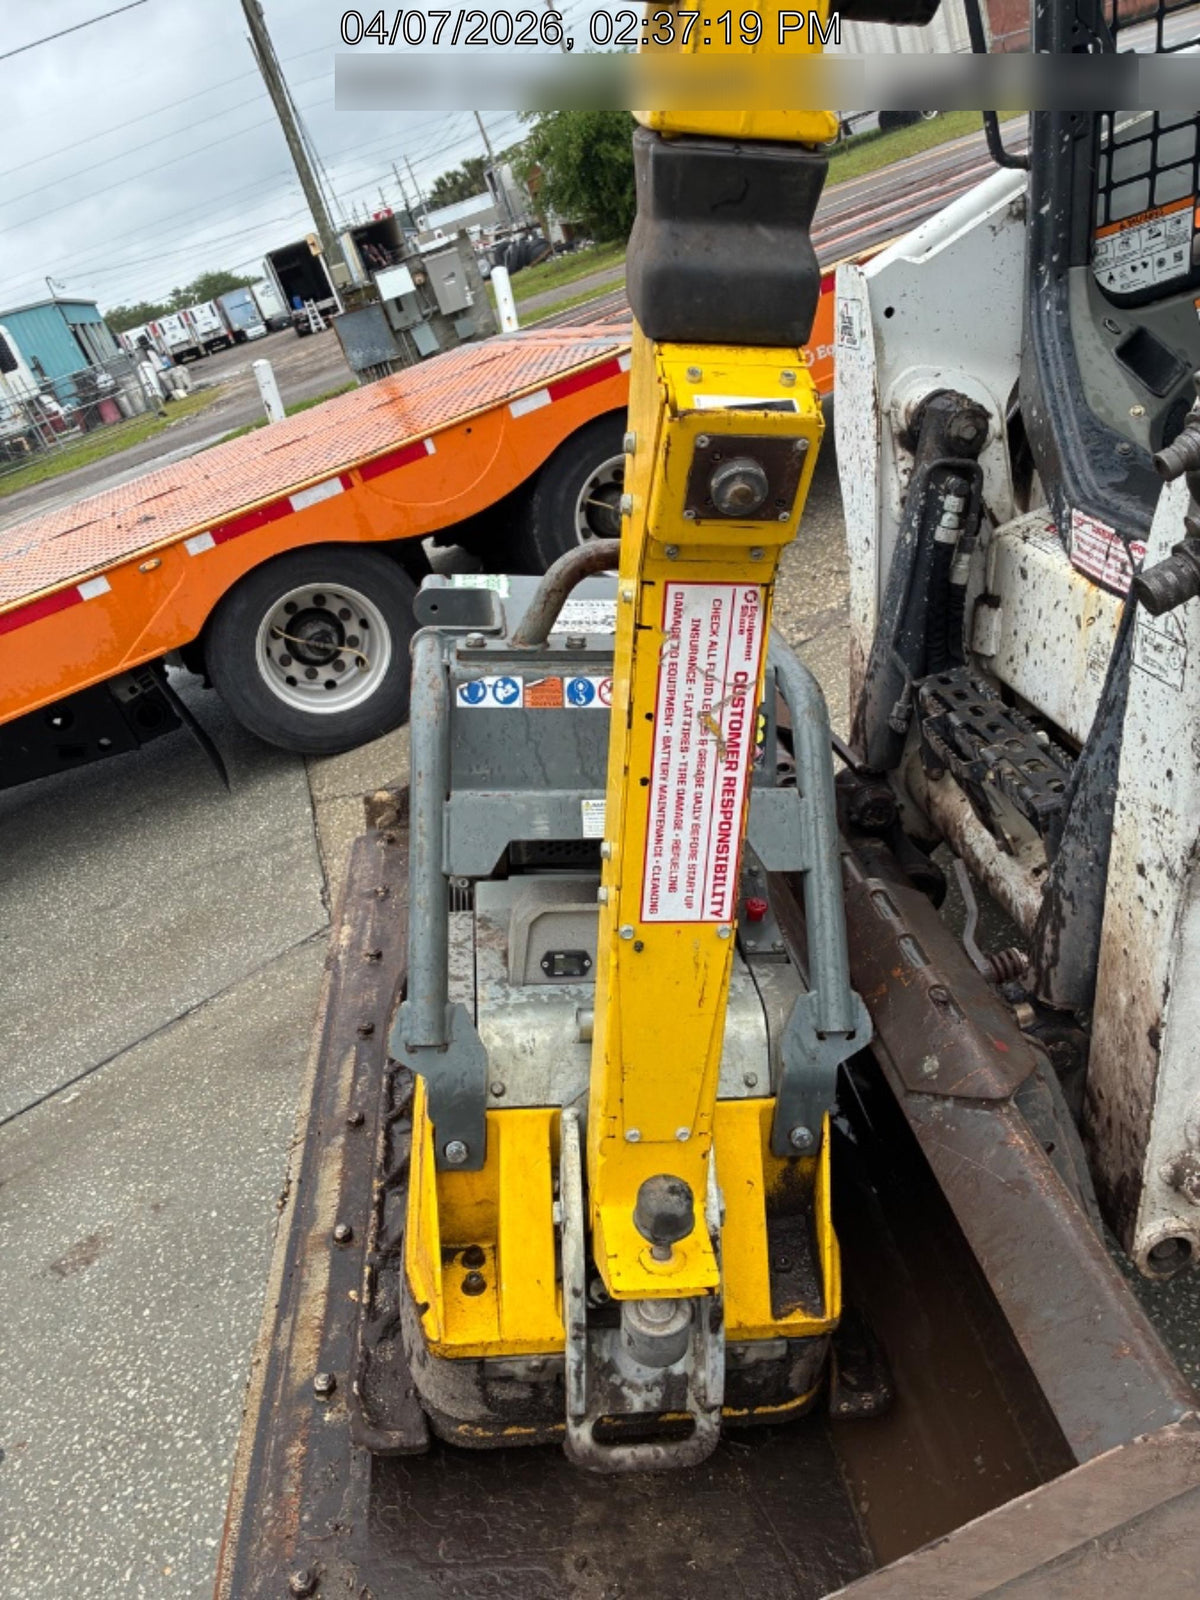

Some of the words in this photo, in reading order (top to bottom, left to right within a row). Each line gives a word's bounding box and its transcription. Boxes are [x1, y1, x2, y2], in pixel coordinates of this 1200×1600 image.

[670, 592, 684, 641] DAMAGE
[709, 599, 722, 637] CHECK
[738, 604, 748, 635] Share
[745, 605, 758, 661] Equipment
[686, 618, 701, 684] INSURANCE
[707, 640, 718, 659] ALL
[664, 662, 678, 727] EQUIPMENT
[704, 662, 715, 695] FLUID
[683, 694, 694, 717] FLAT
[725, 672, 748, 771] CUSTOMER
[680, 720, 692, 753] TIRES
[660, 736, 672, 781] BATTERY
[677, 761, 688, 785] TIRE
[694, 749, 707, 788] GREASE
[653, 785, 668, 858] MAINTENANCE
[673, 789, 685, 830] DAMAGE
[692, 792, 703, 821] DAILY
[688, 823, 701, 861] BEFORE
[710, 777, 736, 918] RESPONSIBILITY
[668, 839, 681, 893] REFUELING
[686, 864, 696, 893] START
[649, 865, 662, 915] CLEANING
[684, 896, 694, 909] UP
